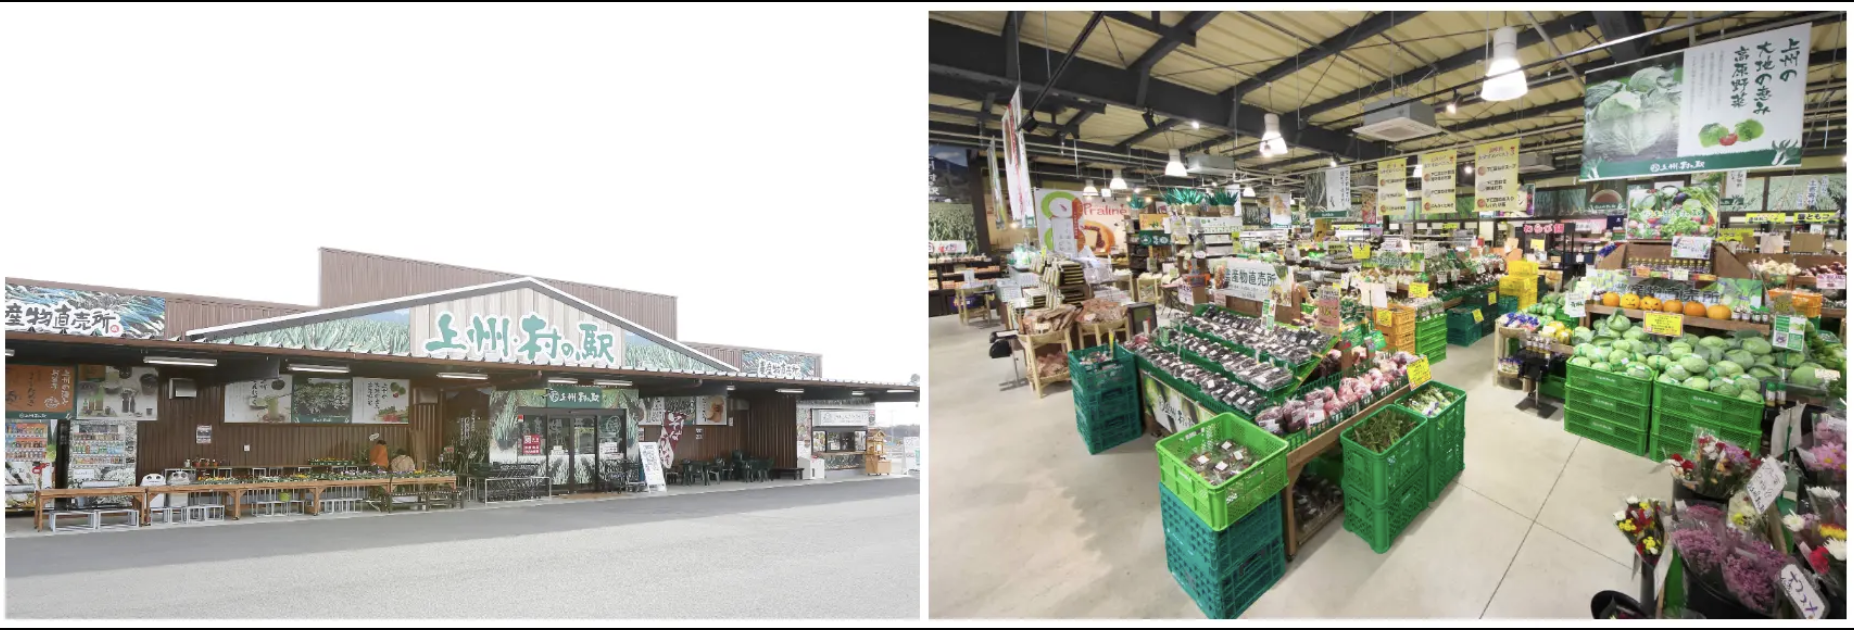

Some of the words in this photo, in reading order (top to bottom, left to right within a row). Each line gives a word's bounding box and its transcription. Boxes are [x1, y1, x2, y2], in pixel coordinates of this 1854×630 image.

[1730, 45, 1750, 109] 高原野菜
[1753, 41, 1776, 116] 大地の恵み
[1779, 38, 1801, 82] 上州の
[1523, 223, 1565, 235] わらび餅
[5, 302, 117, 334] 産物直売所
